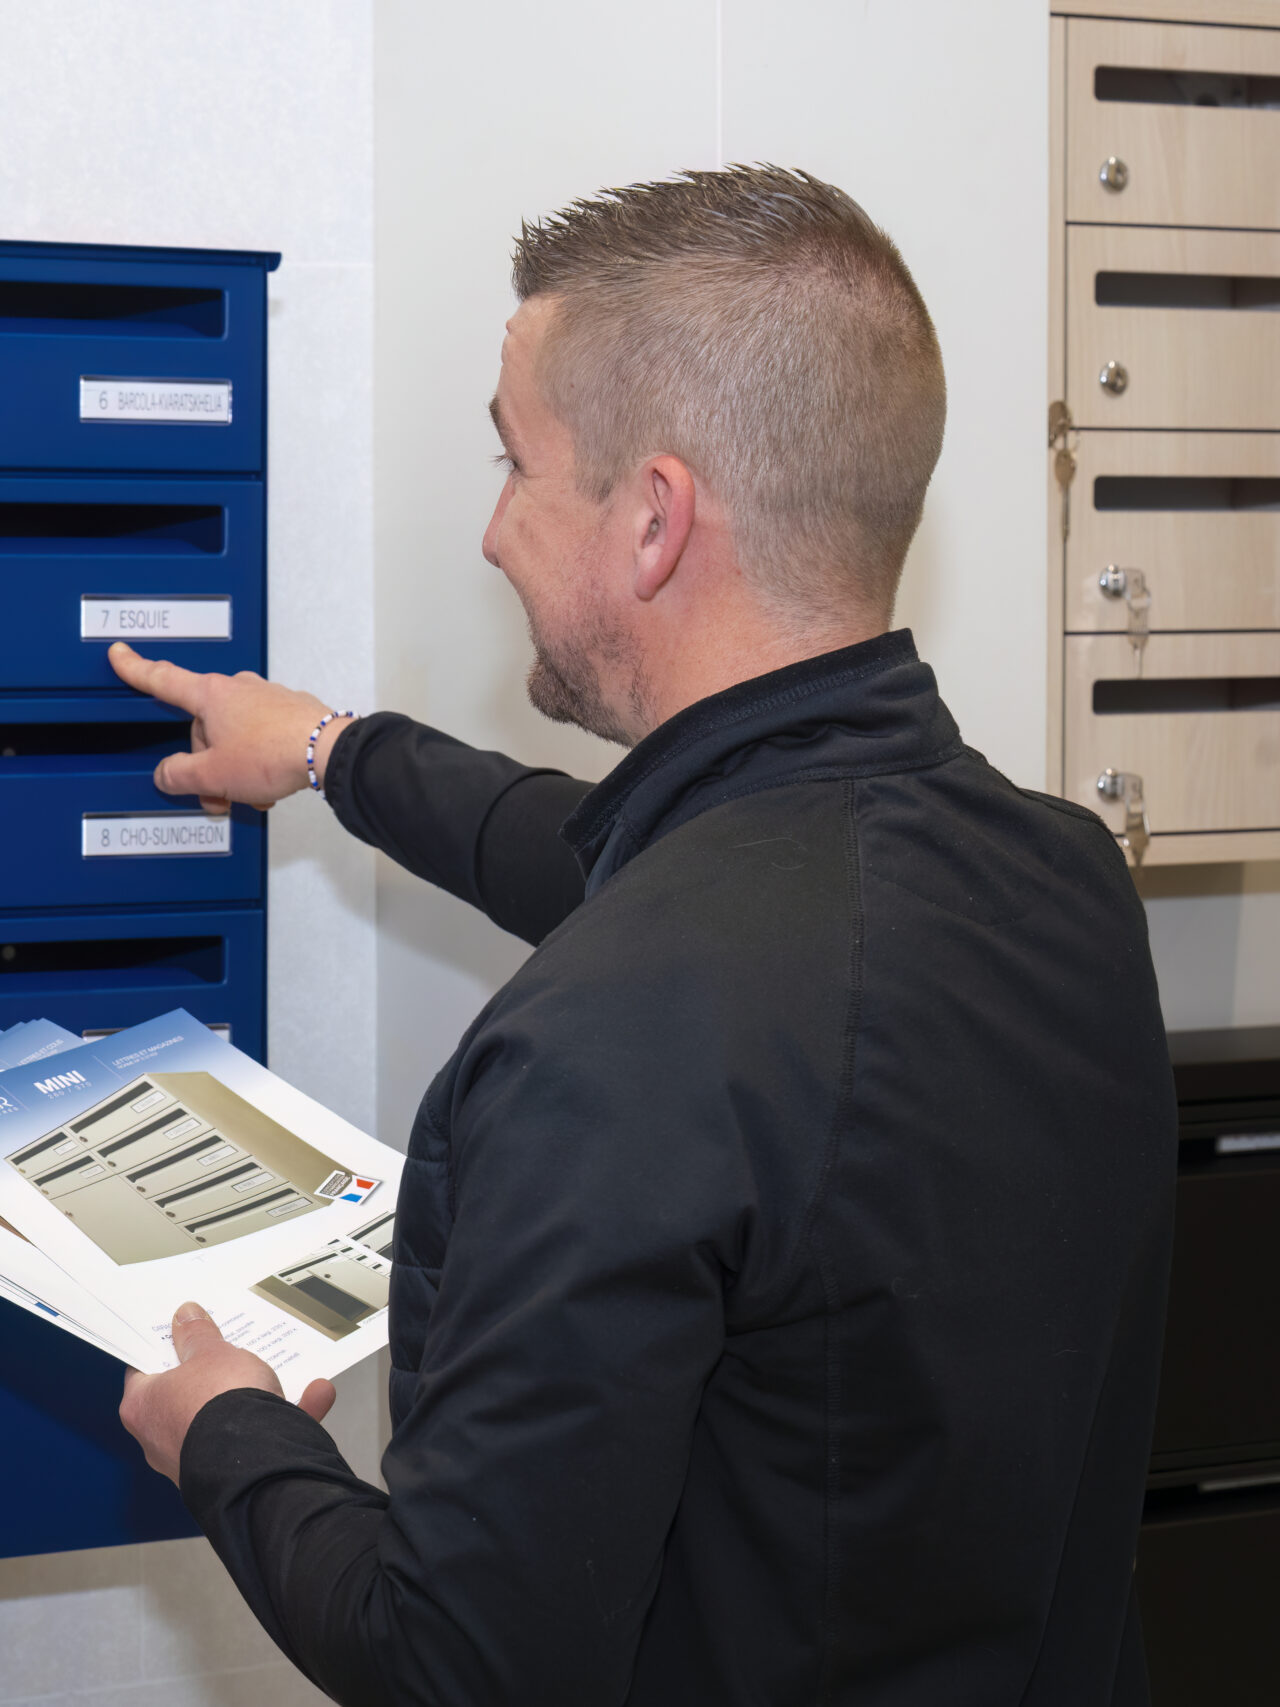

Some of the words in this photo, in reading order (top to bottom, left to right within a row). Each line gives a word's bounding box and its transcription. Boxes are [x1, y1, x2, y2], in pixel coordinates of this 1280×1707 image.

[99, 391, 108, 410] 6
[101, 610, 110, 629] 7
[120, 610, 170, 629] ESQUIE
[101, 828, 110, 847] 8
[120, 826, 224, 847] CHO-SUNCHEON
[33, 1070, 86, 1094] MINI
